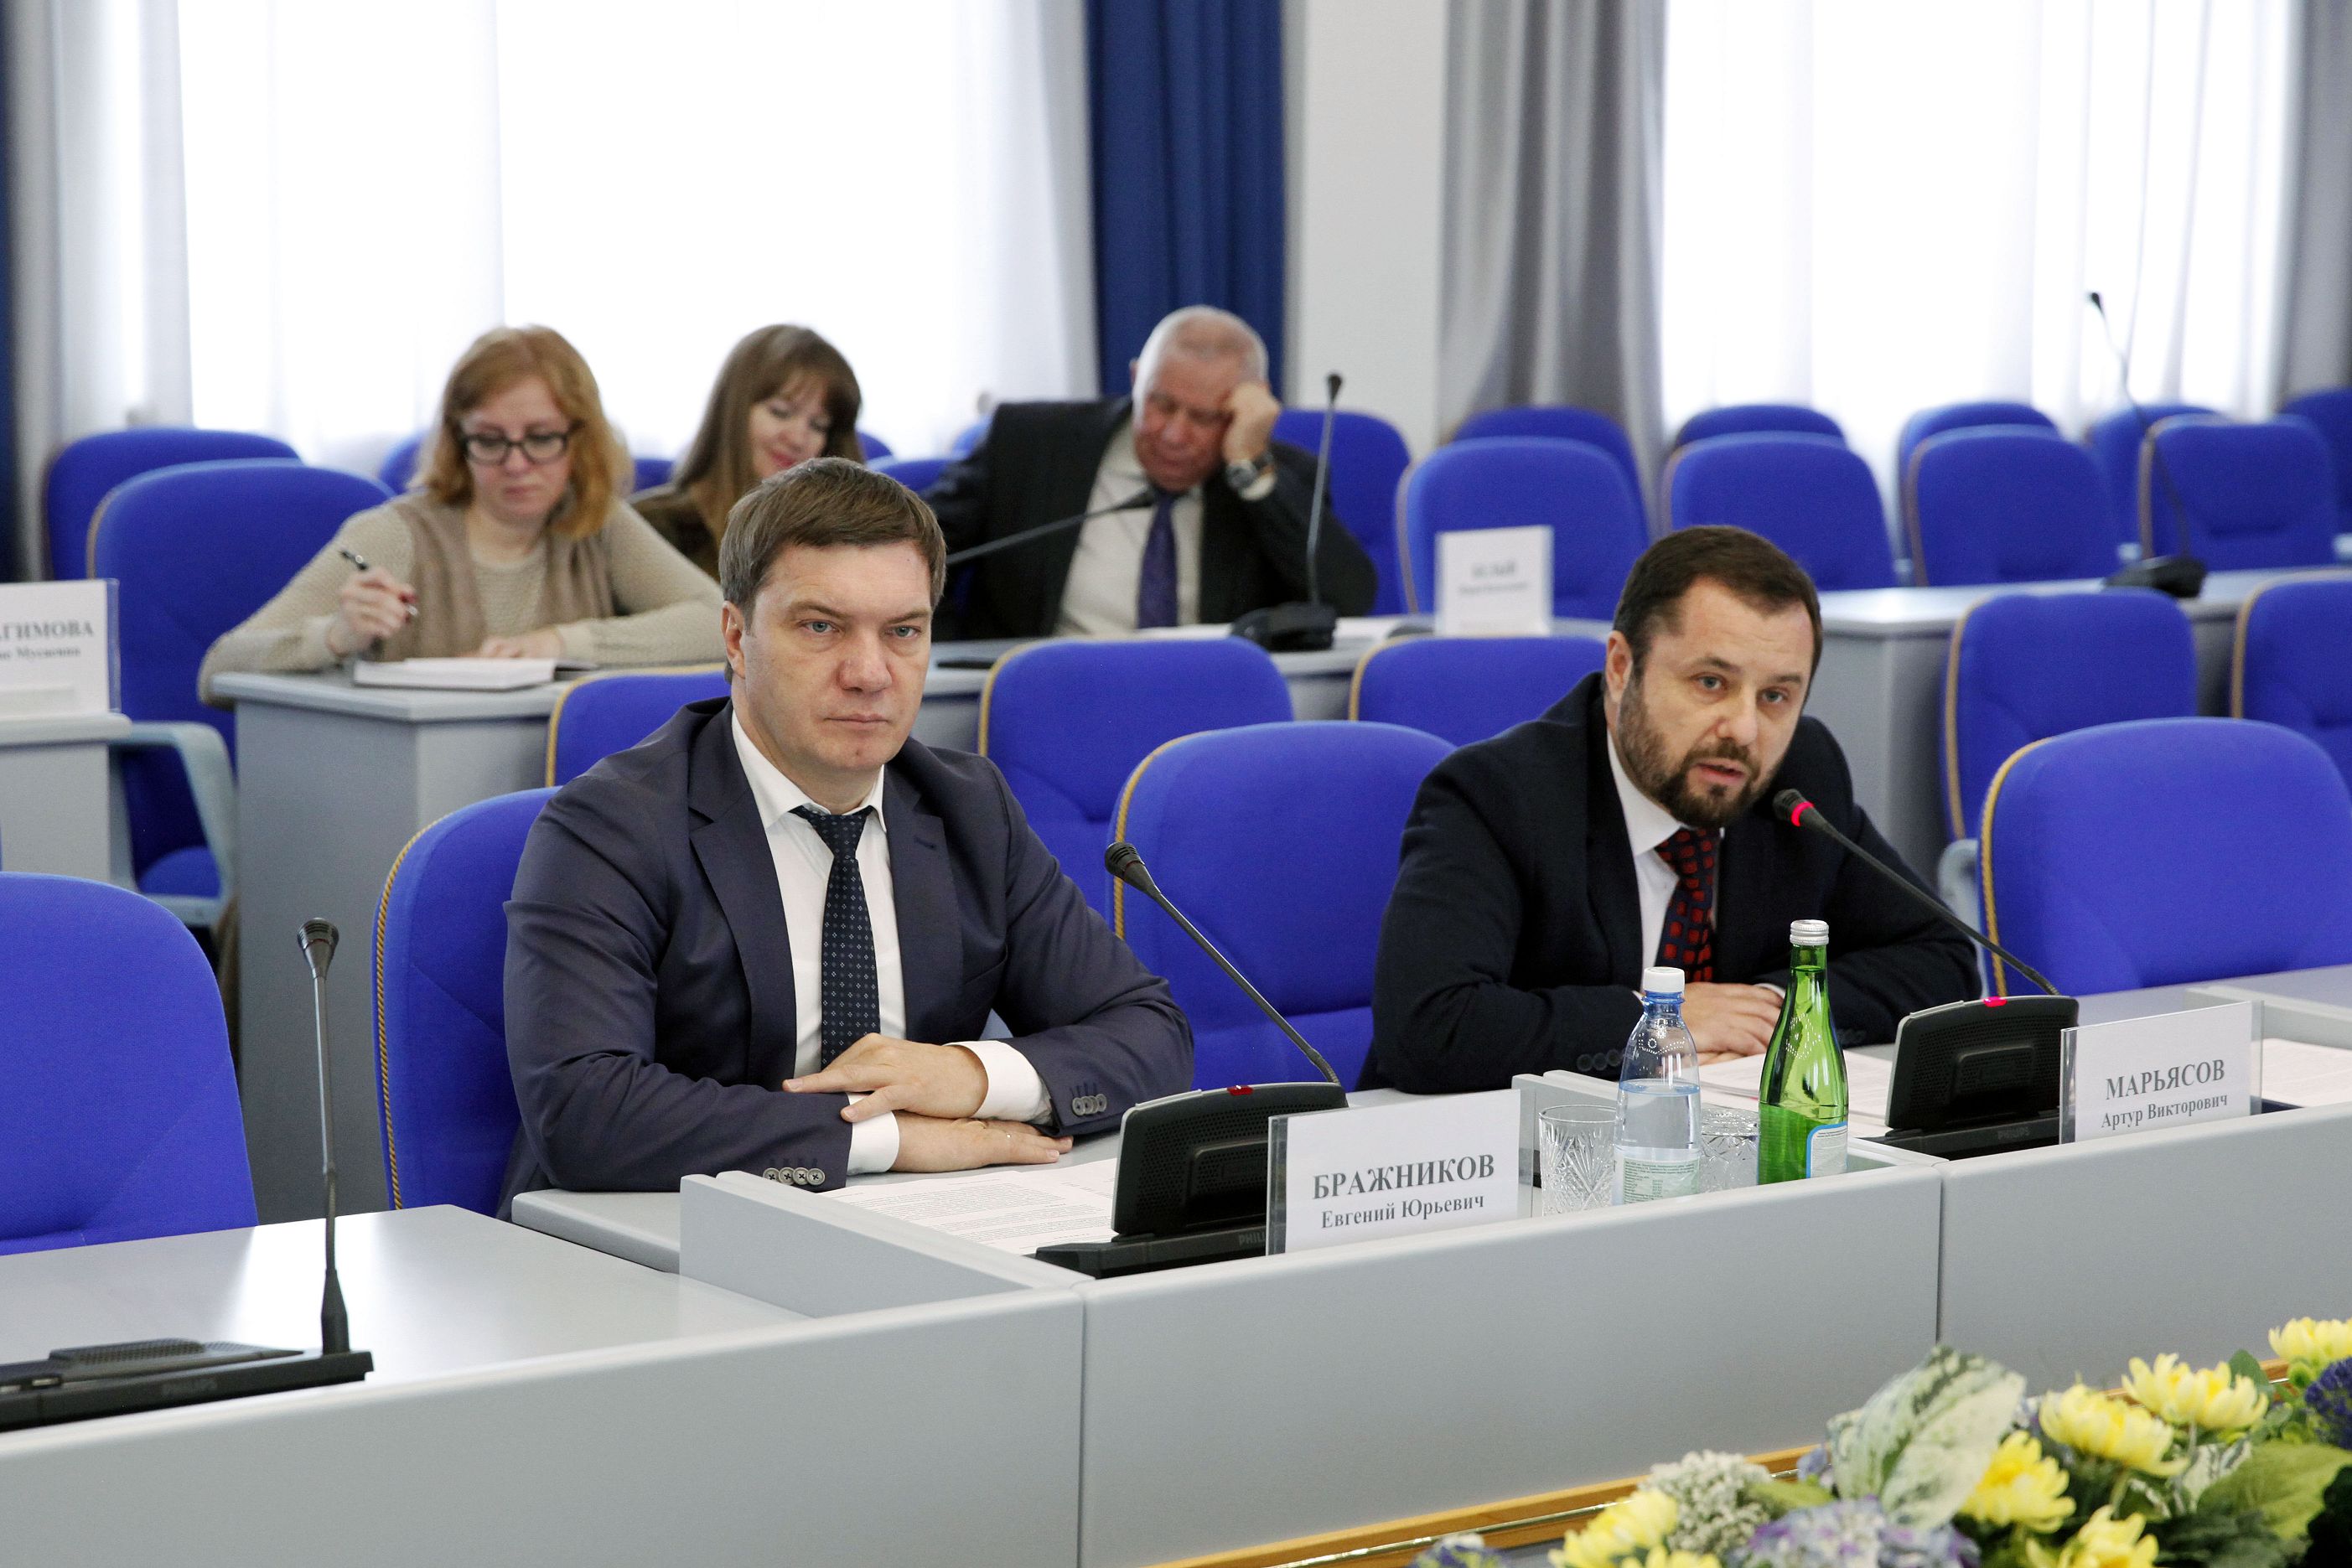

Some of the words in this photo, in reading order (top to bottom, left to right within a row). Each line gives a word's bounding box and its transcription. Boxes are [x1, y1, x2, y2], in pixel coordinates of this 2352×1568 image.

[2105, 1058, 2226, 1100] МАРЬЯСОВ
[2101, 1109, 2143, 1130] Артур
[2147, 1094, 2229, 1118] Викторович
[1313, 1153, 1495, 1199] БРАЖНИКОВ
[1322, 1203, 1396, 1229] Евгений
[1401, 1195, 1484, 1219] Юрьевич
